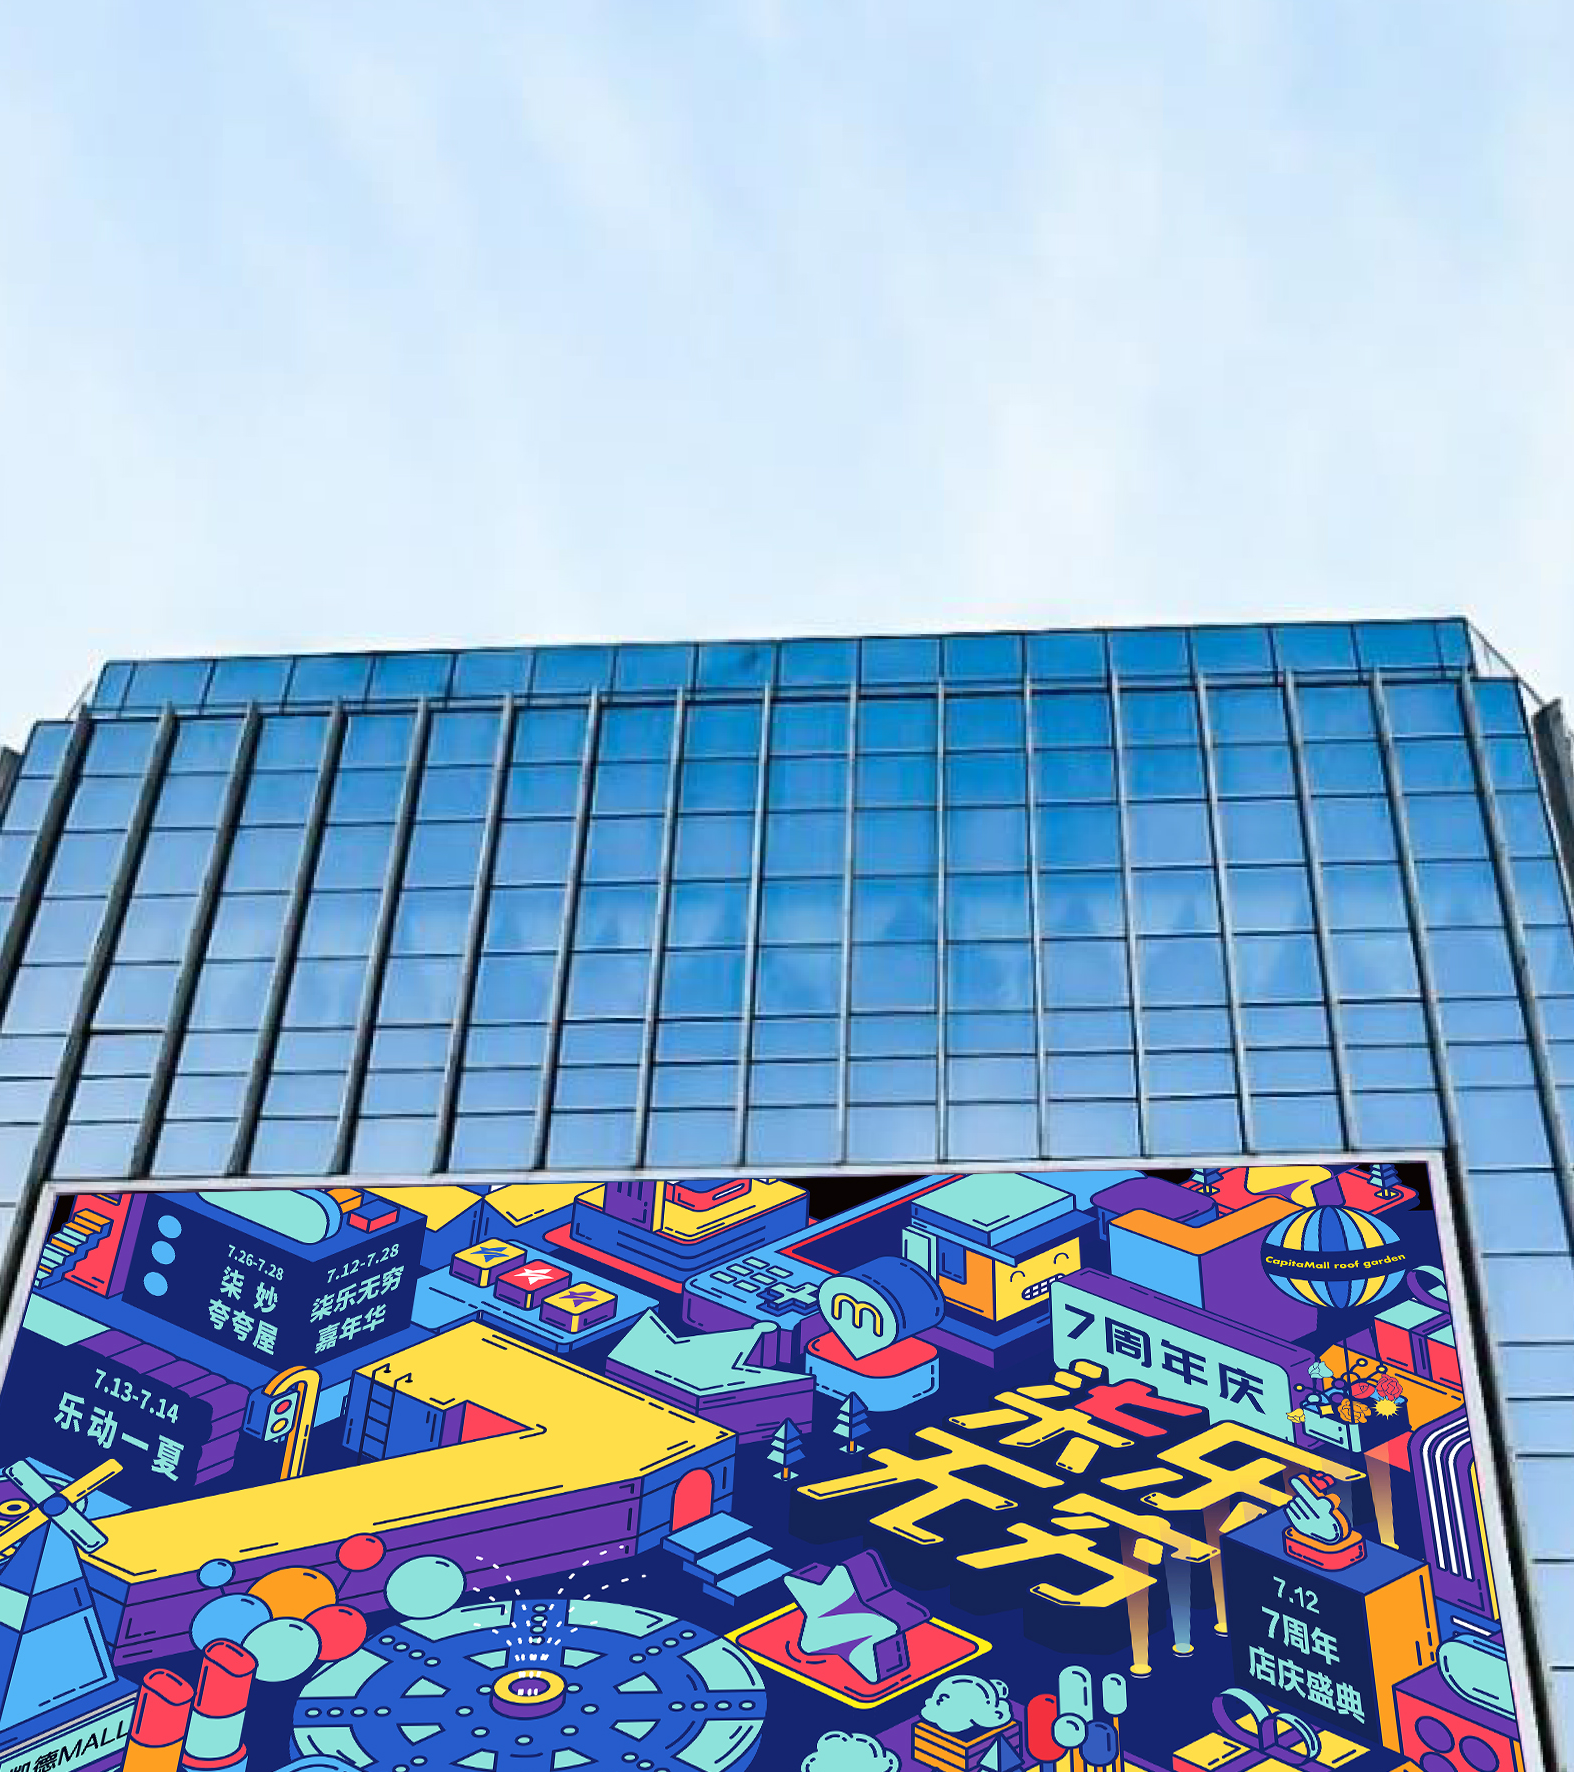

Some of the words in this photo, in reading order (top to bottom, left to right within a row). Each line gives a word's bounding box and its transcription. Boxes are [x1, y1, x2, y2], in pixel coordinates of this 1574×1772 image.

[228, 1244, 284, 1281] 7.26-7.28
[327, 1244, 400, 1283] 7.12-7.28
[1265, 1255, 1330, 1270] CapitaMall
[1334, 1260, 1360, 1270] roof
[1363, 1254, 1406, 1269] garden
[310, 1265, 404, 1323] 柒乐无穷
[208, 1298, 278, 1355] 夸夸屋
[315, 1304, 386, 1354] 嘉年华
[1062, 1303, 1267, 1415] 7周年庆
[94, 1368, 179, 1424] 7.13-7.14
[54, 1391, 184, 1481] 乐动一夏
[1273, 1576, 1320, 1614] 7.12
[1261, 1605, 1340, 1666] 7周年
[1249, 1645, 1365, 1725] 店庆盛典
